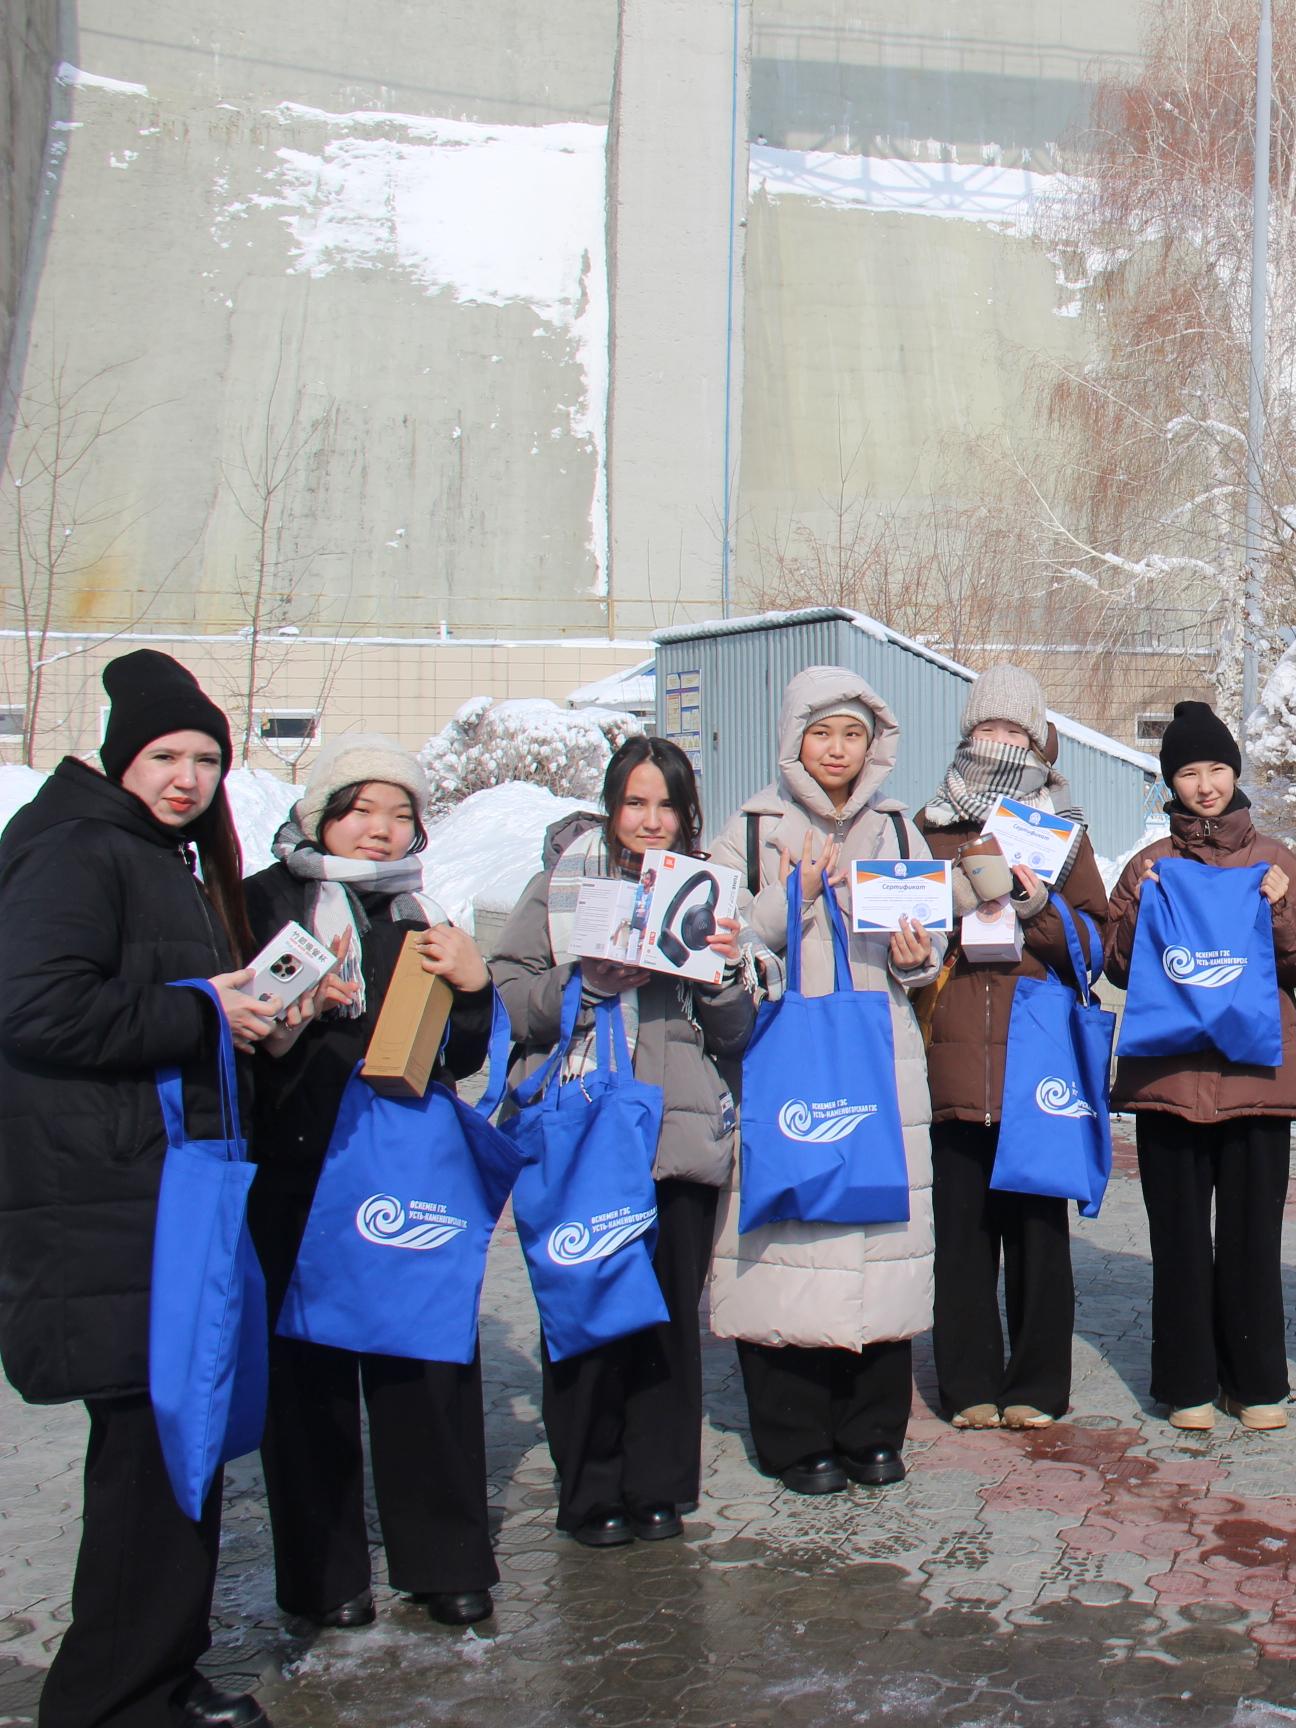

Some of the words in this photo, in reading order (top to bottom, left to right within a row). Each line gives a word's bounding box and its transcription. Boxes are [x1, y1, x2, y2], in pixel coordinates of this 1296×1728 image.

[882, 883, 926, 891] Сертификат
[1219, 949, 1231, 957] ГЭС
[836, 1098, 848, 1107] ГЭС
[618, 1206, 631, 1217] ГЭС
